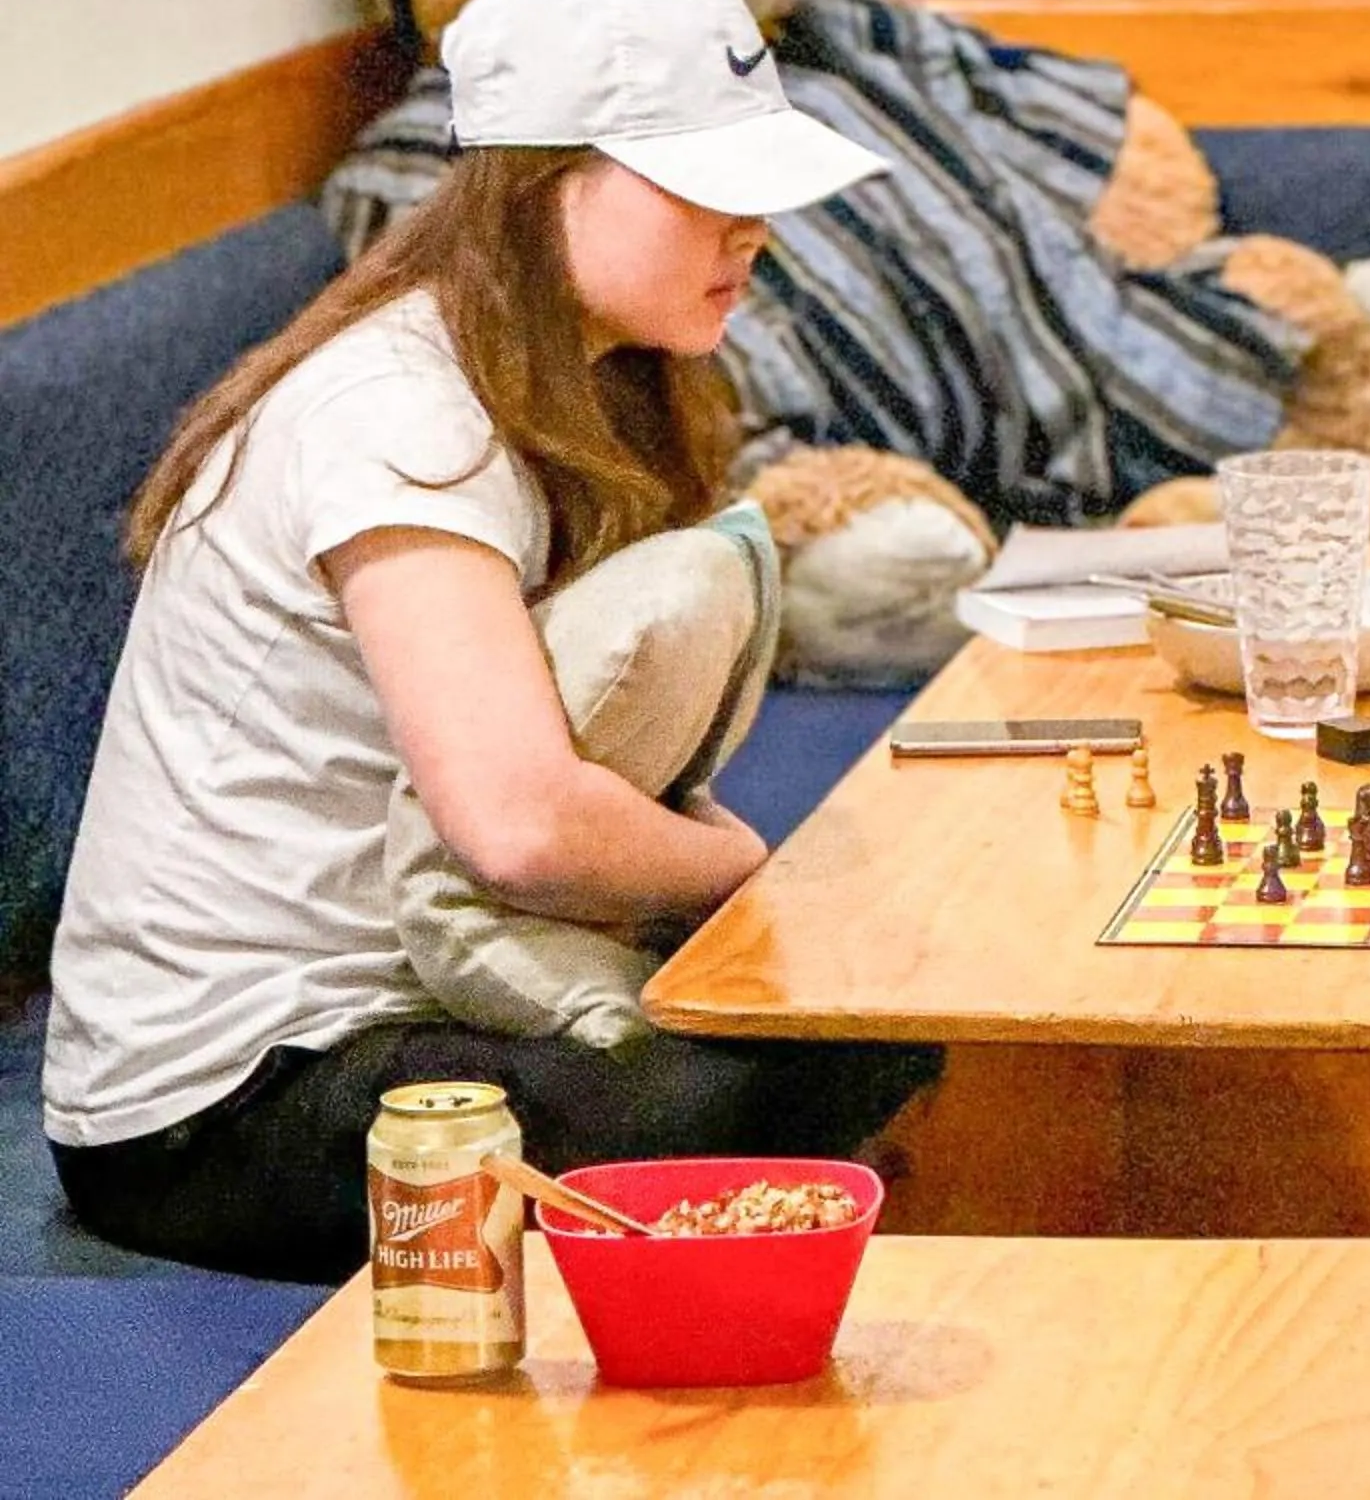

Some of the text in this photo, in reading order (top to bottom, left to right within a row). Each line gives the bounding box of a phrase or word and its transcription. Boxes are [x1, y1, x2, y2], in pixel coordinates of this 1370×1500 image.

[382, 1198, 466, 1241] Miller
[378, 1245, 480, 1269] HIGH LIFE
